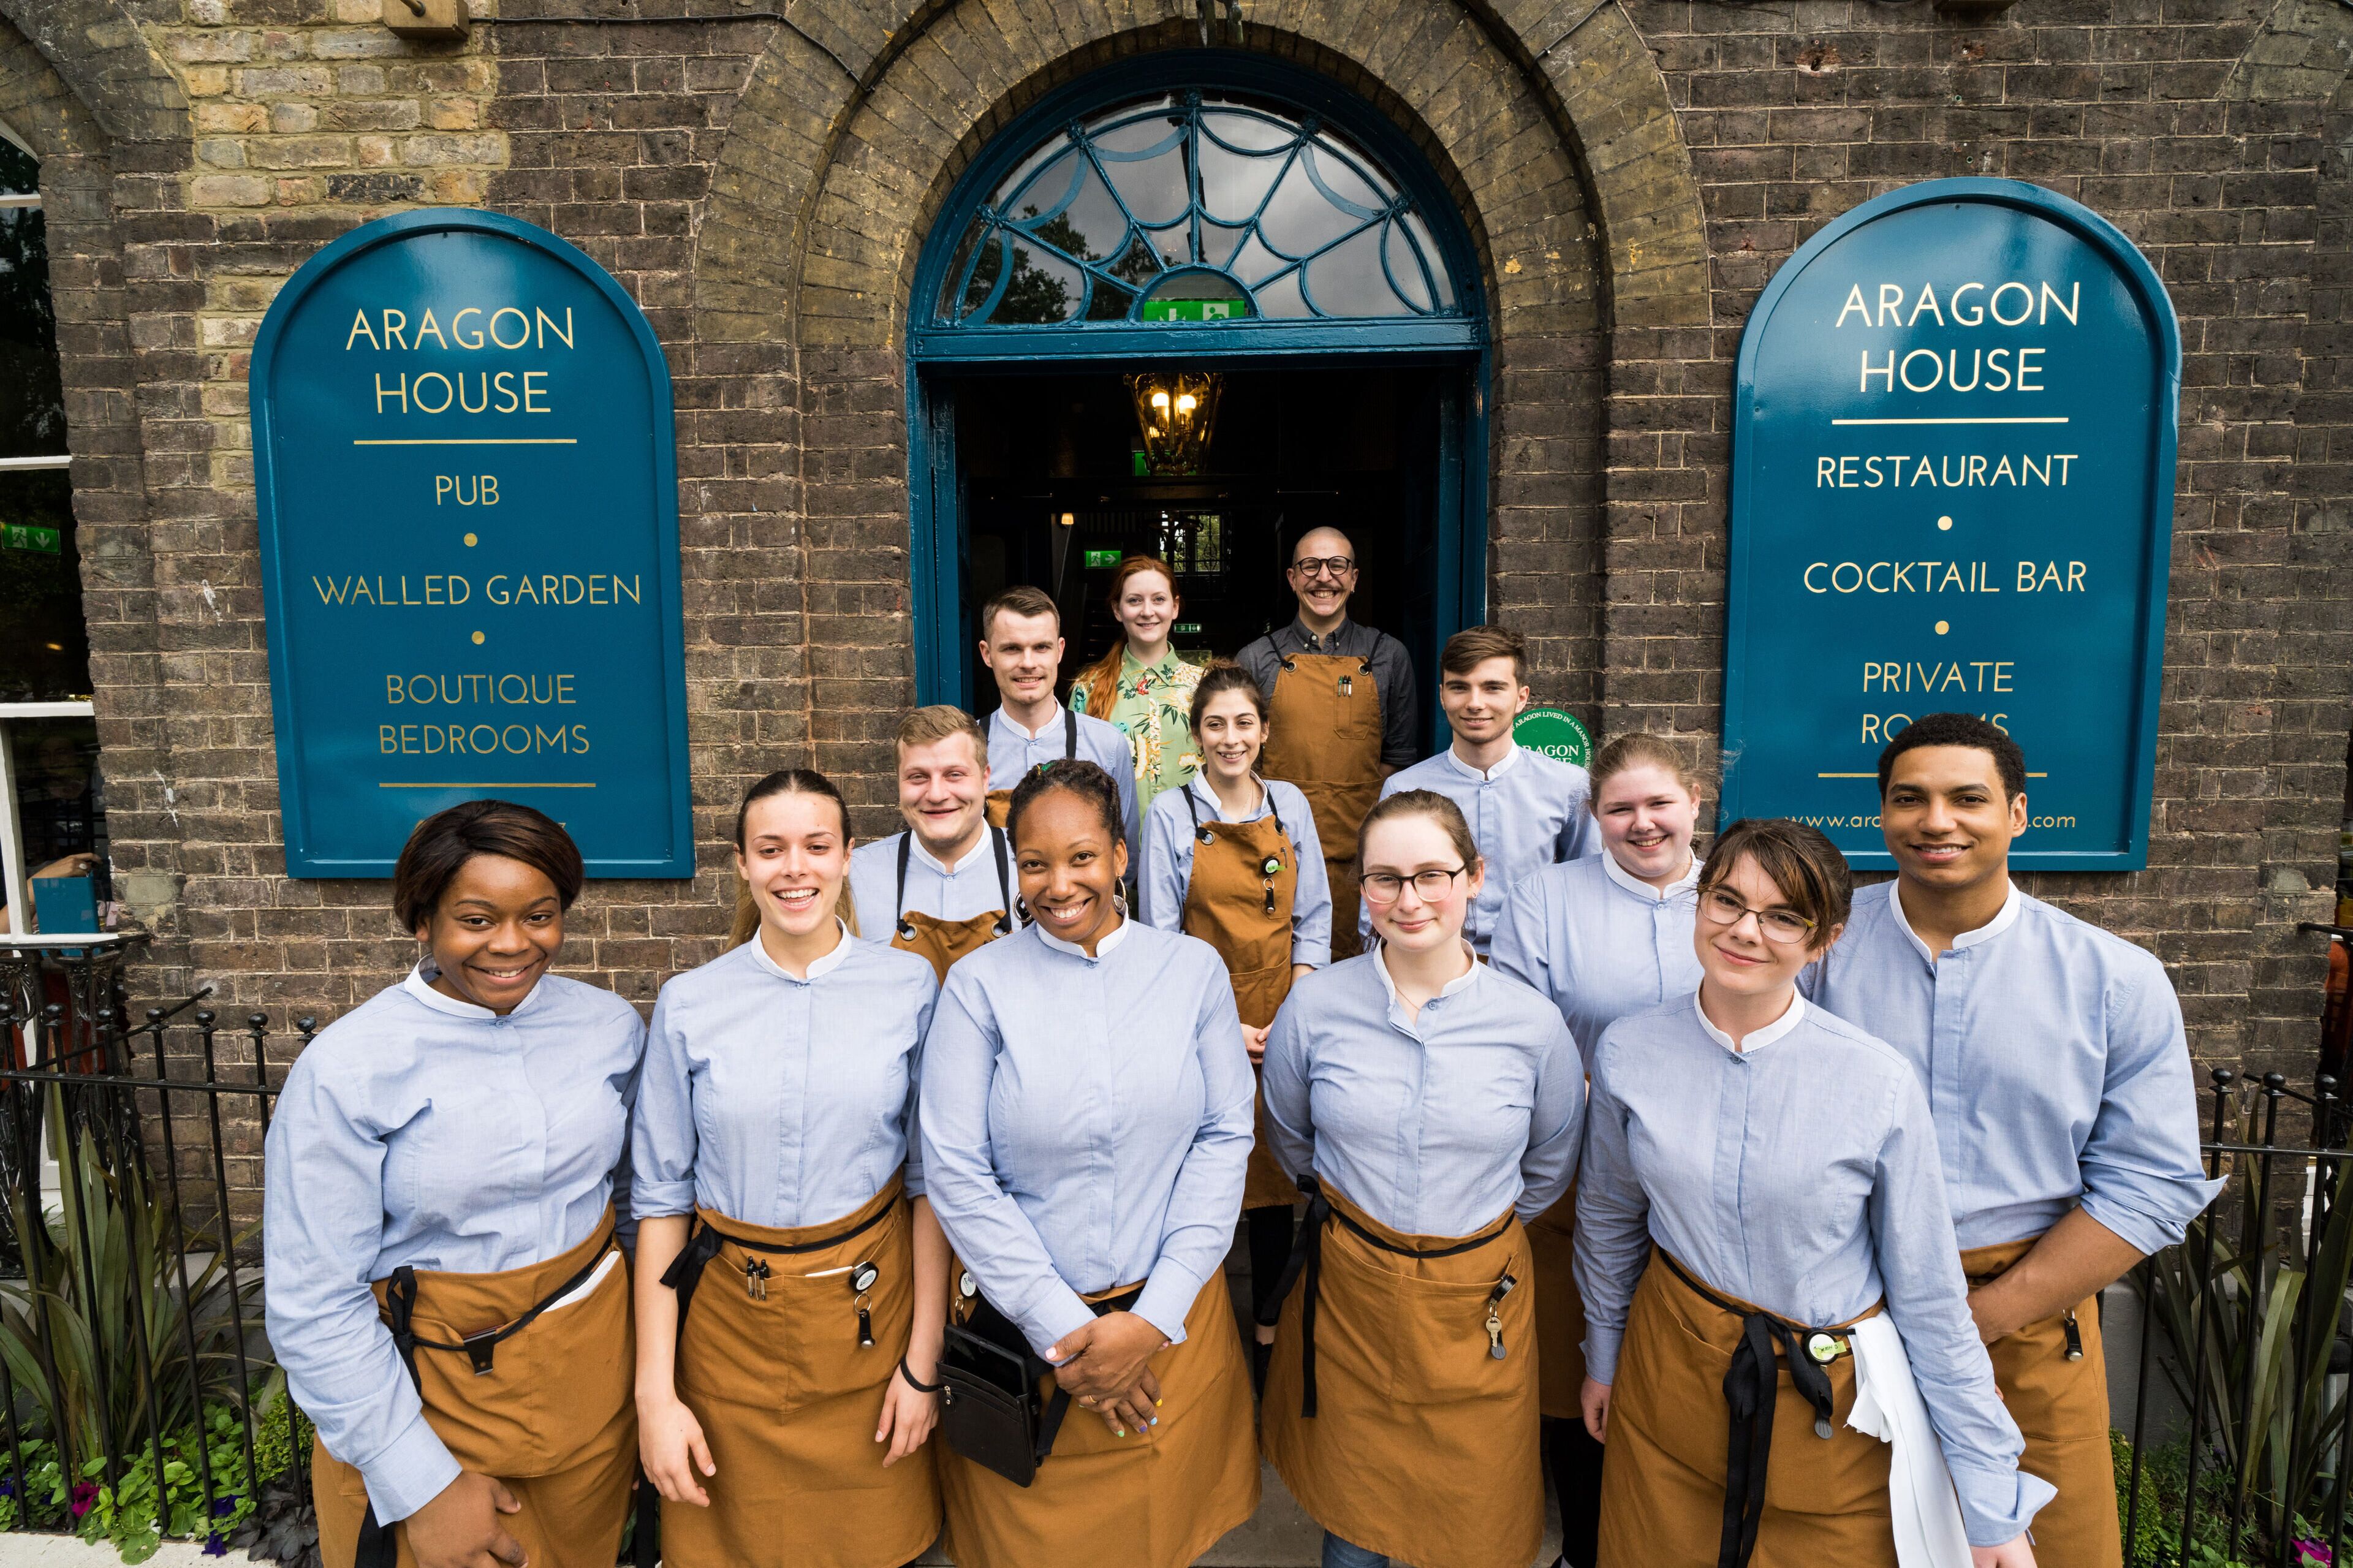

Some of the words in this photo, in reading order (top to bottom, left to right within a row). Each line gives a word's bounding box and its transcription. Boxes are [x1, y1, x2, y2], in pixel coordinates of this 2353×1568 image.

[1836, 281, 2079, 328] ARAGON
[346, 307, 574, 350] ARAGON
[1860, 348, 2045, 393] HOUSE
[375, 371, 551, 414] HOUSE
[1817, 455, 2078, 488] RESTAURANT
[436, 475, 499, 506] PUB
[313, 575, 470, 605] WALLED
[486, 575, 640, 605] GARDEN
[1804, 561, 2000, 593] COCKTAIL
[2017, 561, 2086, 592] BAR
[387, 674, 576, 704] BOUTIQUE
[1863, 662, 2014, 692] PRIVATE
[379, 724, 589, 754] BEDROOMS
[1515, 711, 1541, 728] ARAGON
[1542, 711, 1563, 720] LIVED
[1574, 724, 1590, 748] MANOR
[1862, 713, 2009, 744] ROS
